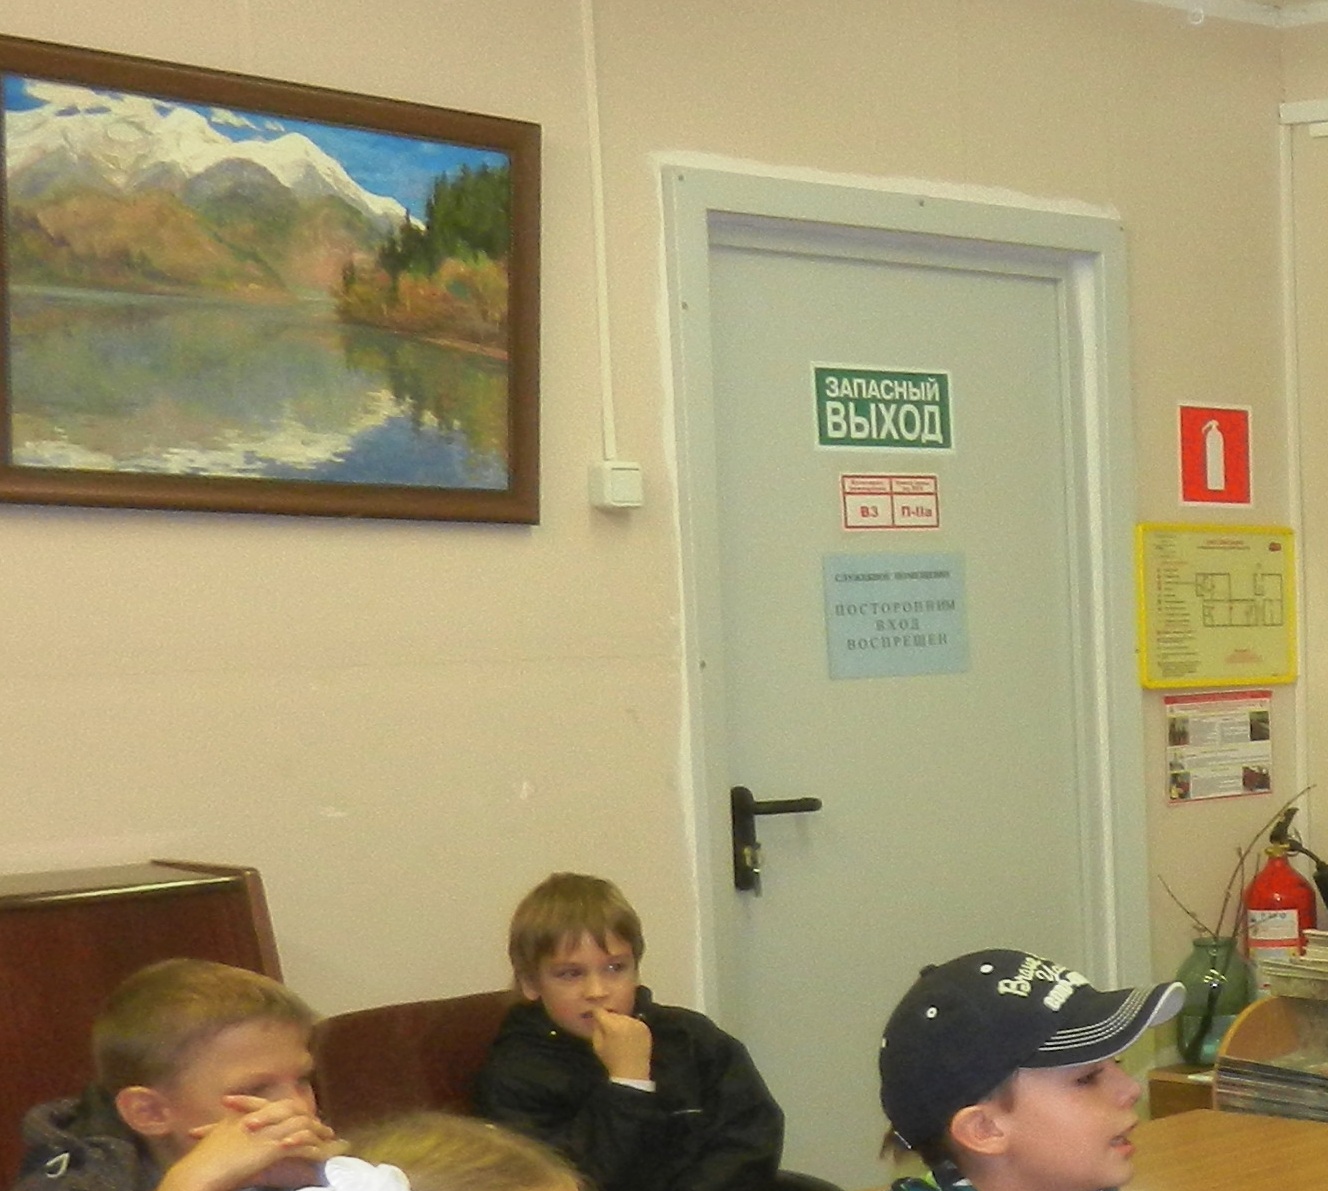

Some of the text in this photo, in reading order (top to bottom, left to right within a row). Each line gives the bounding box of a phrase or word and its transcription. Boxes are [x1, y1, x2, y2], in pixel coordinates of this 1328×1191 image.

[825, 376, 940, 401] ЗАПАСНЫЙ
[826, 400, 943, 444] ВЫХОД
[835, 600, 955, 616] ПОСТОРОННИМ
[876, 618, 919, 631] ВХОД
